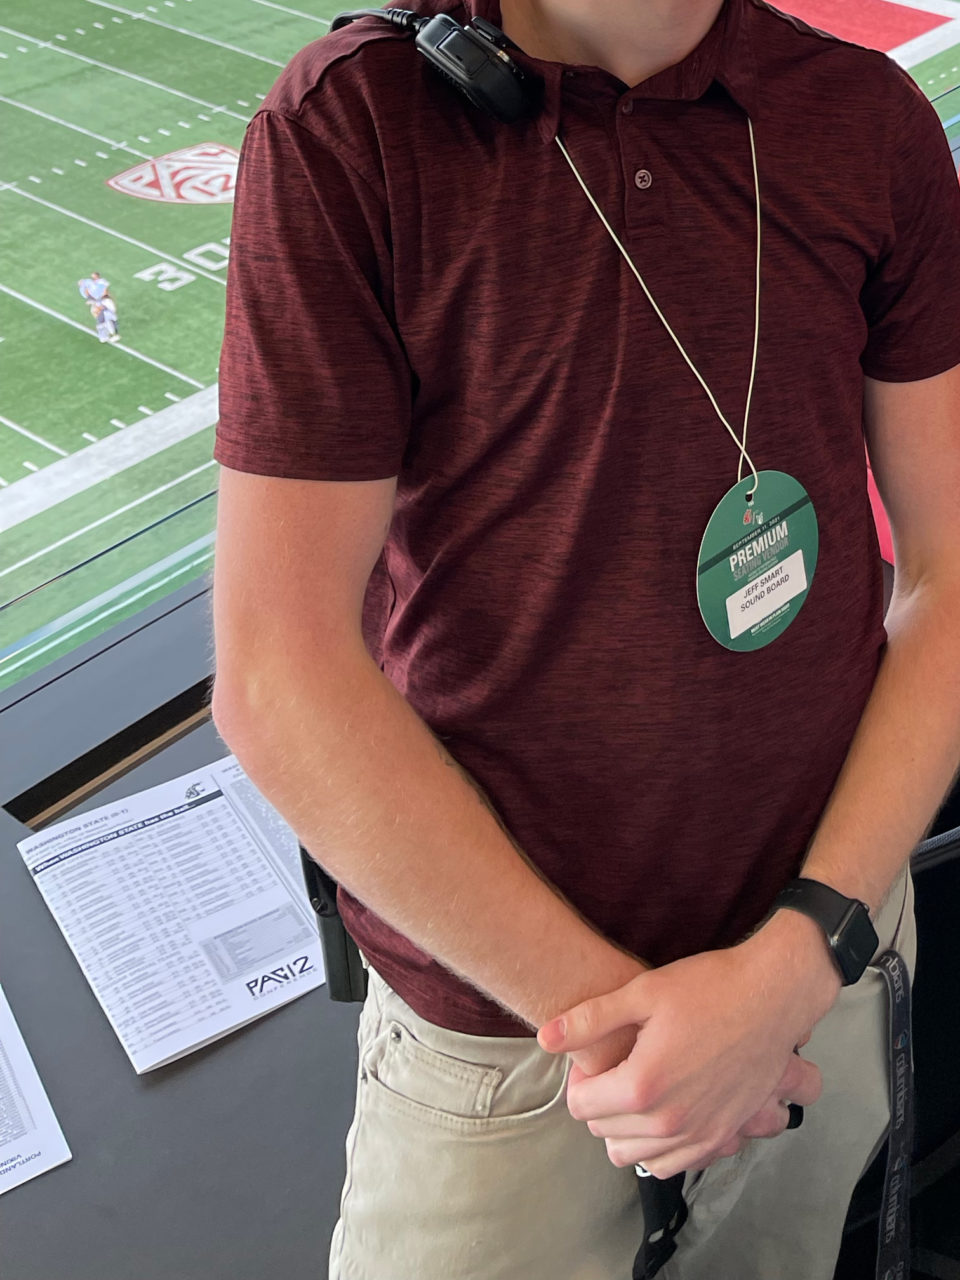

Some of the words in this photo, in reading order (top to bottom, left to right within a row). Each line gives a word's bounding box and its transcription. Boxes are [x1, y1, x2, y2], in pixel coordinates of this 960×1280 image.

[729, 520, 789, 572] PREMIUM
[740, 591, 765, 613] SOUND
[766, 574, 790, 596] BOARD
[743, 583, 759, 599] JEFF
[760, 566, 784, 588] SMART
[60, 832, 118, 860] WASHINGTON
[118, 822, 144, 837] STATE
